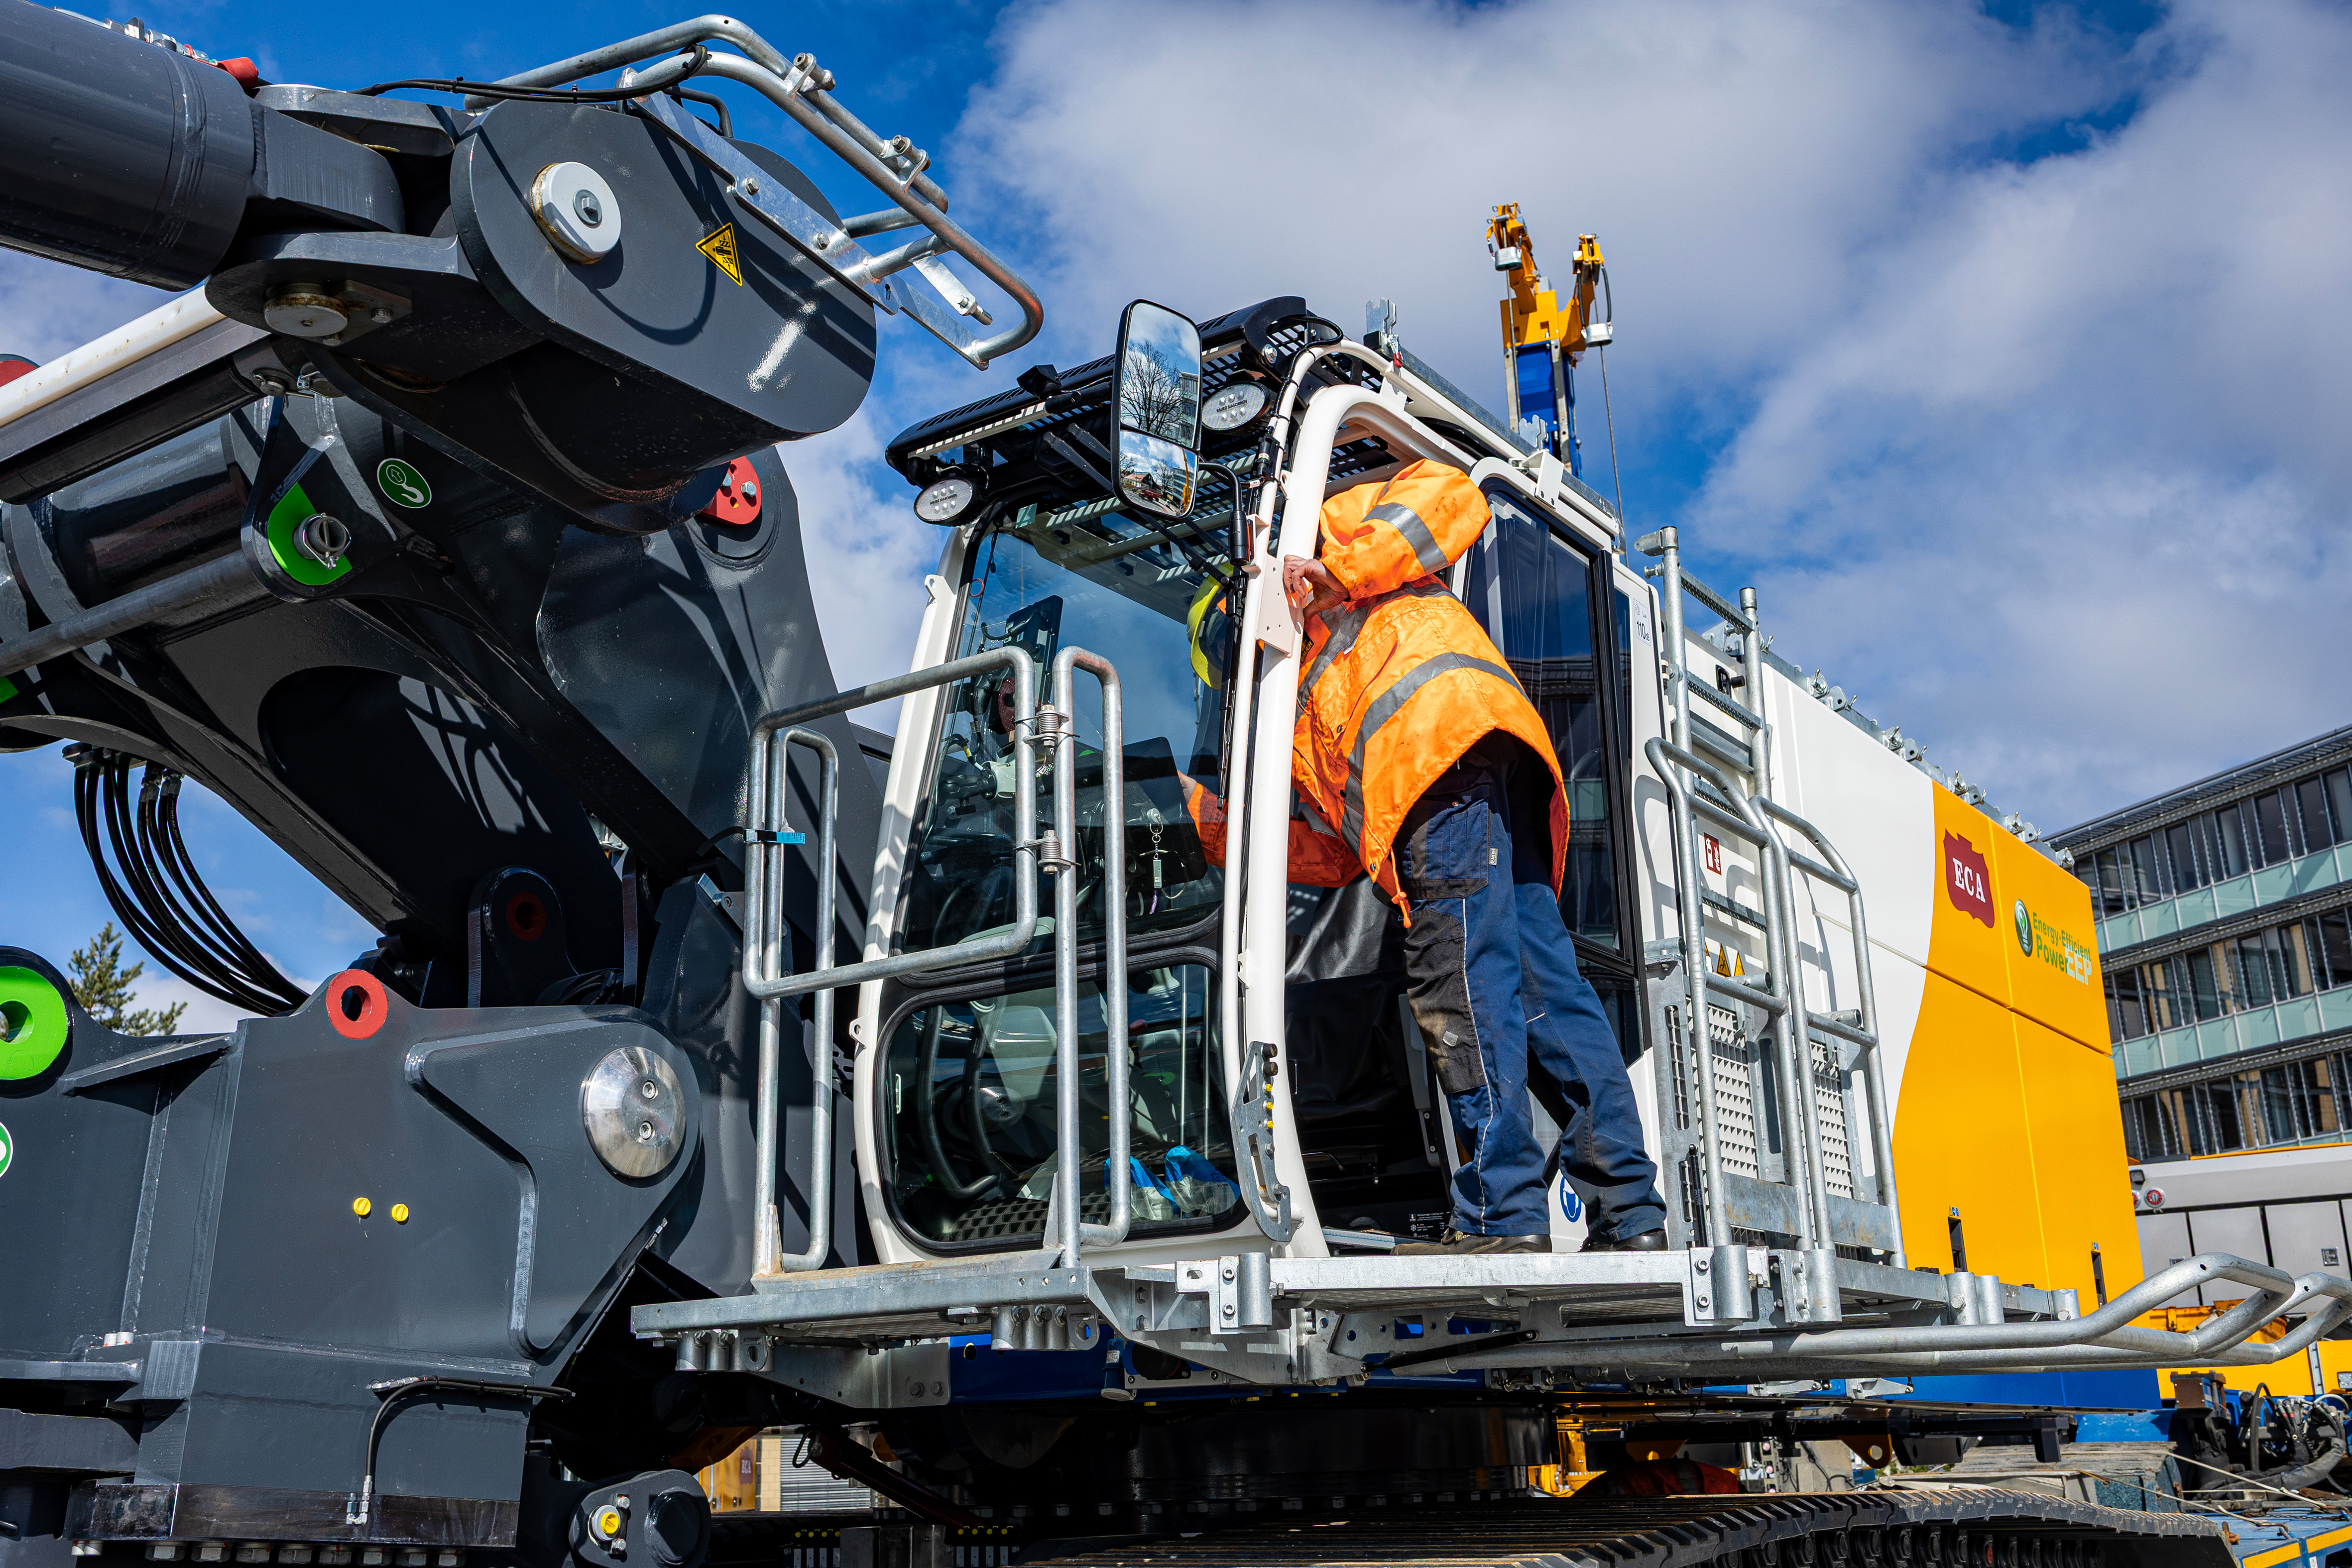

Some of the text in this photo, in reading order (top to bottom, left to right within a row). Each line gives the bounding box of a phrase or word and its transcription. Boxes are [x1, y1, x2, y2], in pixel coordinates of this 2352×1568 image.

[1227, 399, 1247, 409] MASCHINEN
[1300, 641, 1313, 663] BAUER
[1952, 857, 1986, 903] ECA
[2033, 911, 2091, 962] Energy-Efficient
[2036, 933, 2068, 974] Power
[2064, 942, 2092, 986] EEP
